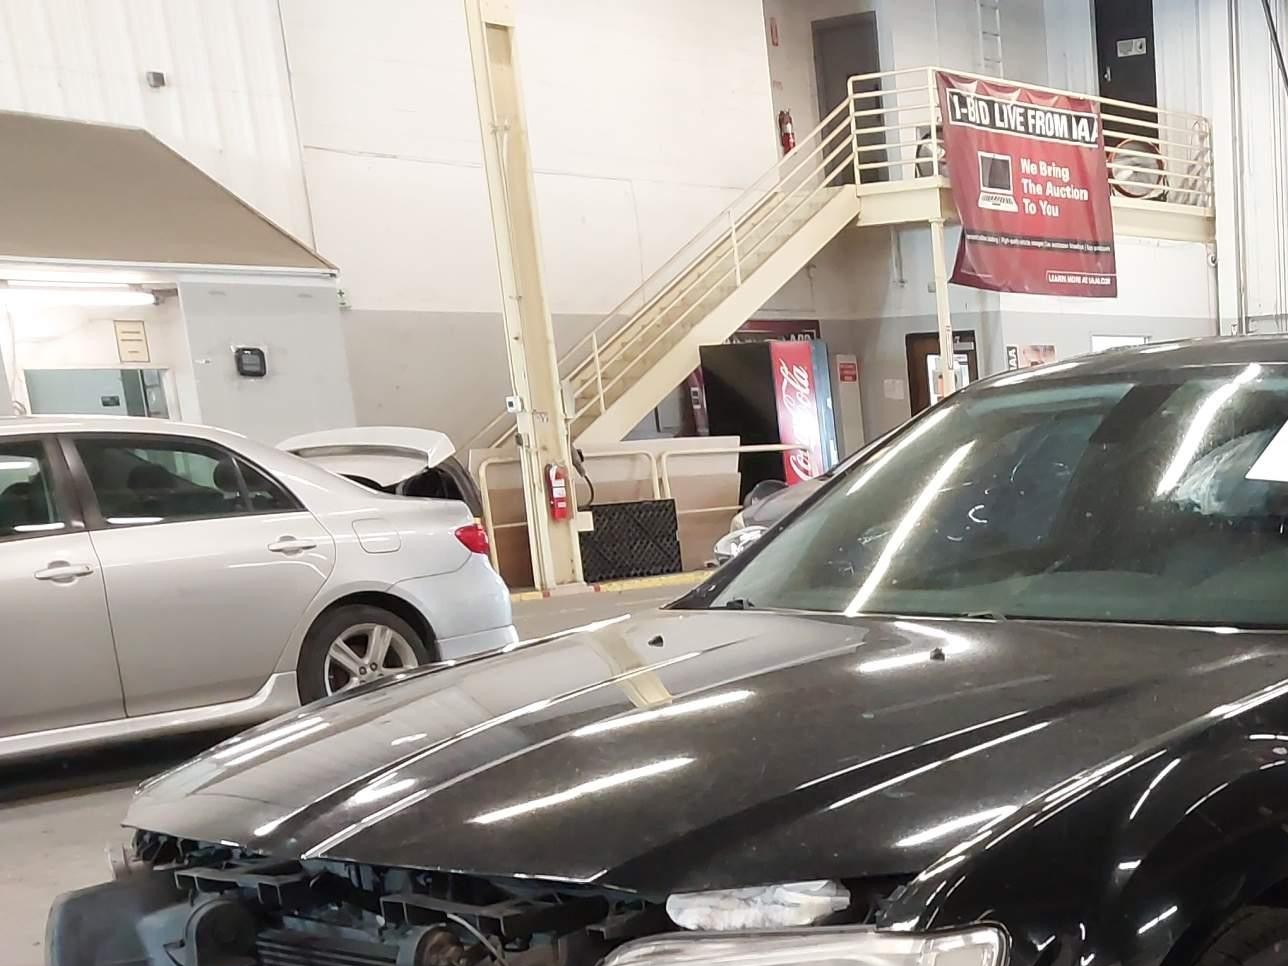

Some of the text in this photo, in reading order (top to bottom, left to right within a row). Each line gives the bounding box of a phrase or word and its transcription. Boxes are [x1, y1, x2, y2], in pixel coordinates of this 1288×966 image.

[994, 103, 1025, 132] LIVE
[1027, 109, 1069, 138] FROM
[1020, 158, 1070, 183] We Bring
[1021, 178, 1089, 201] The Auction
[1022, 198, 1059, 217] To You
[778, 358, 815, 481] CocCola
